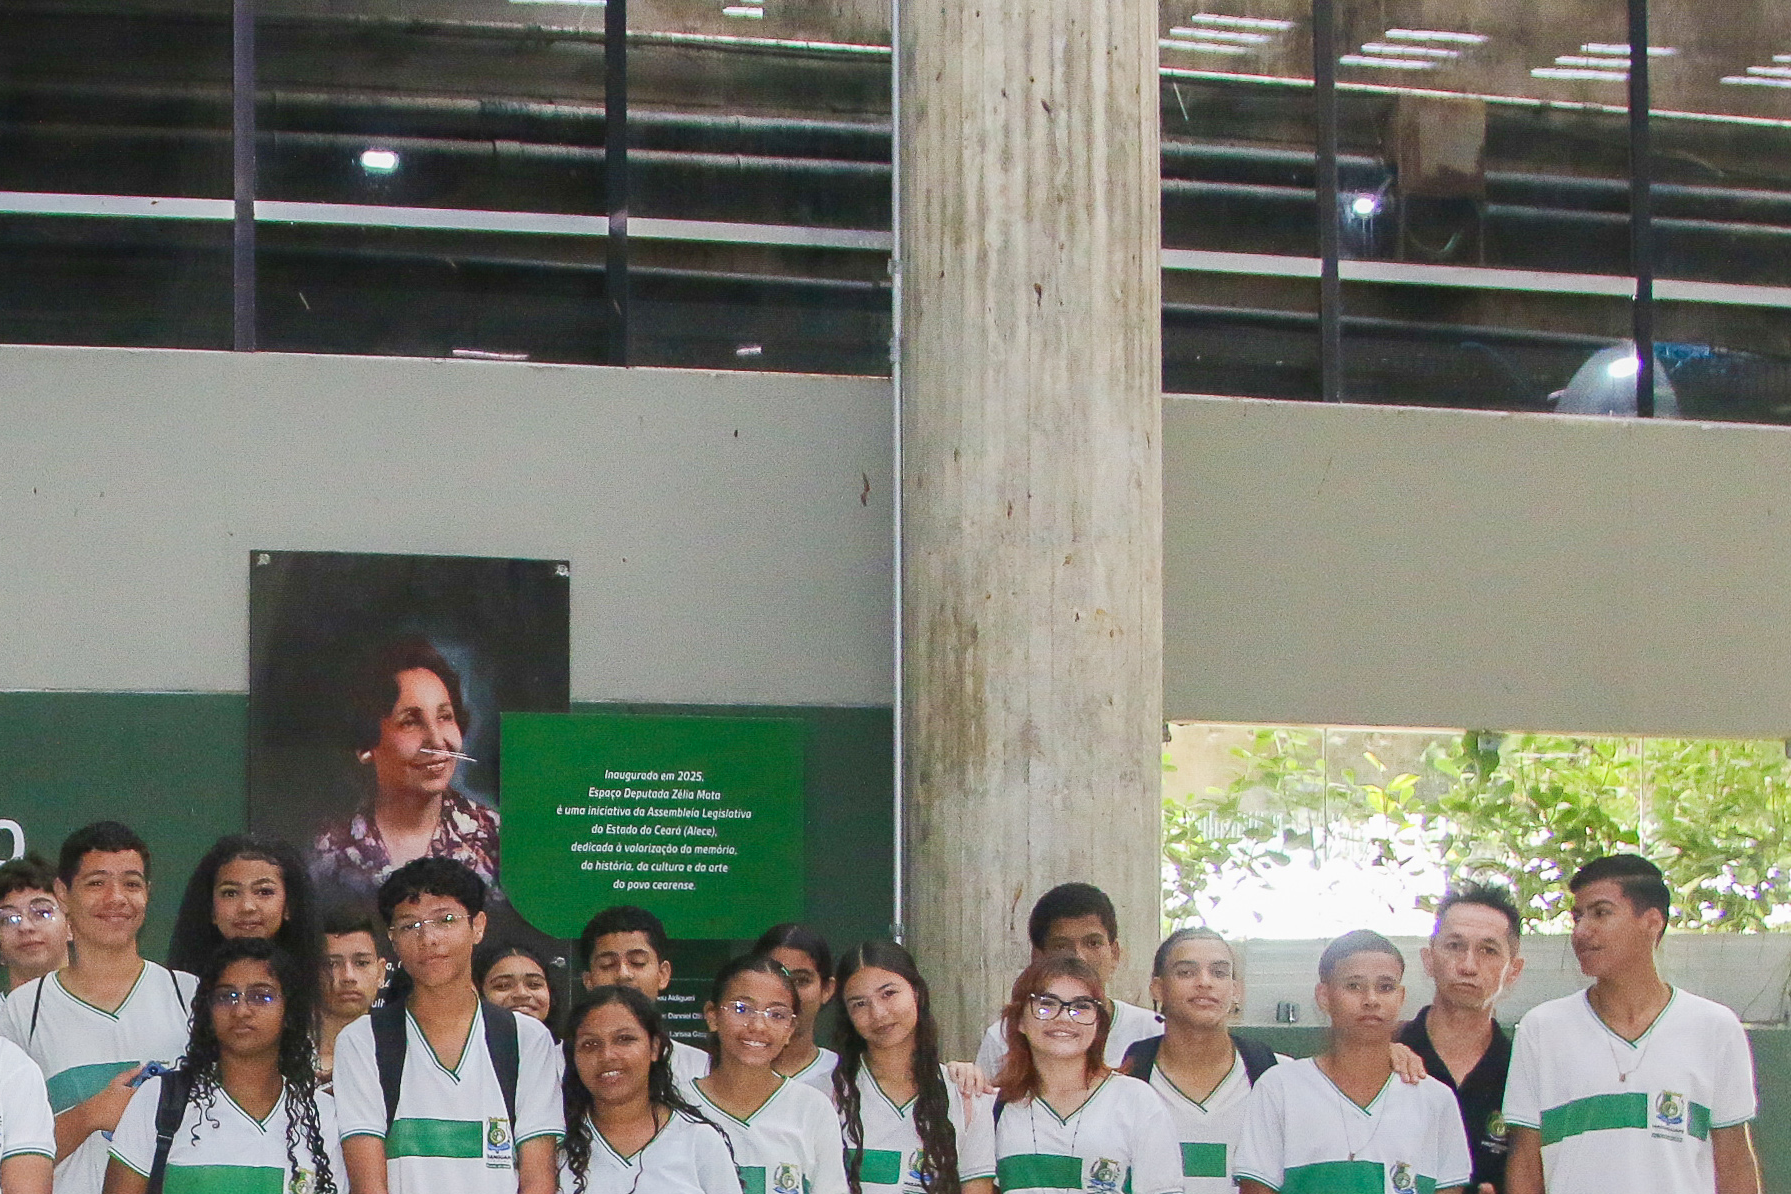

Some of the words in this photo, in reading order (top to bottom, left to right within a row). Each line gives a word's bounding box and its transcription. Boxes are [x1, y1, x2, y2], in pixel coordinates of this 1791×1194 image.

[660, 772, 676, 782] em
[588, 786, 622, 801] Espaço
[623, 787, 670, 801] Deputada
[556, 804, 563, 815] é
[564, 806, 587, 816] uma
[587, 805, 632, 817] iniciativa
[646, 806, 700, 818] Assembleia
[701, 808, 752, 821] Legislativa
[605, 823, 638, 835] Estado
[654, 824, 682, 836] Ceará
[570, 841, 614, 853] dedicada
[650, 861, 685, 872] cultura
[686, 863, 693, 873] e
[708, 863, 729, 873] arte
[626, 881, 651, 892] povo
